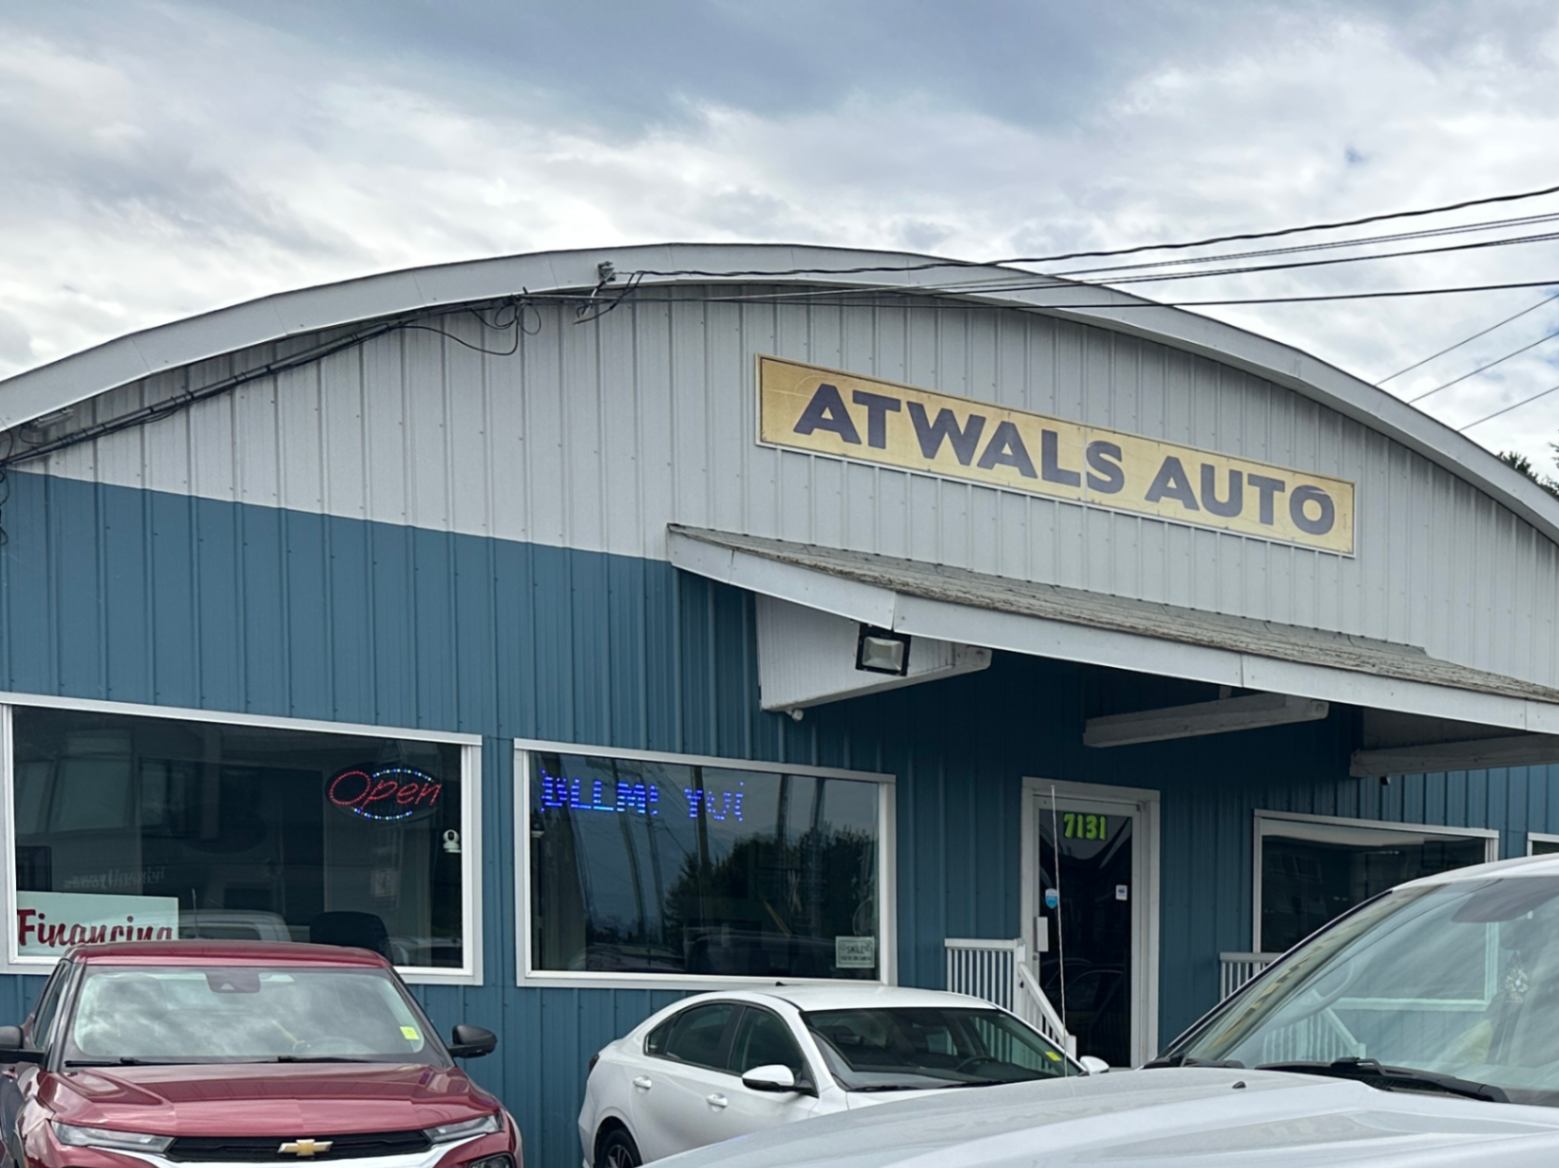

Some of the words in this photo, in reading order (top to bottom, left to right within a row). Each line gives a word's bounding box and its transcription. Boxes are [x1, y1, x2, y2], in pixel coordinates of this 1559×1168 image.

[793, 383, 1125, 494] ATWALS
[1144, 456, 1336, 536] AUTO
[328, 769, 443, 813] Open
[1063, 812, 1106, 840] 7131
